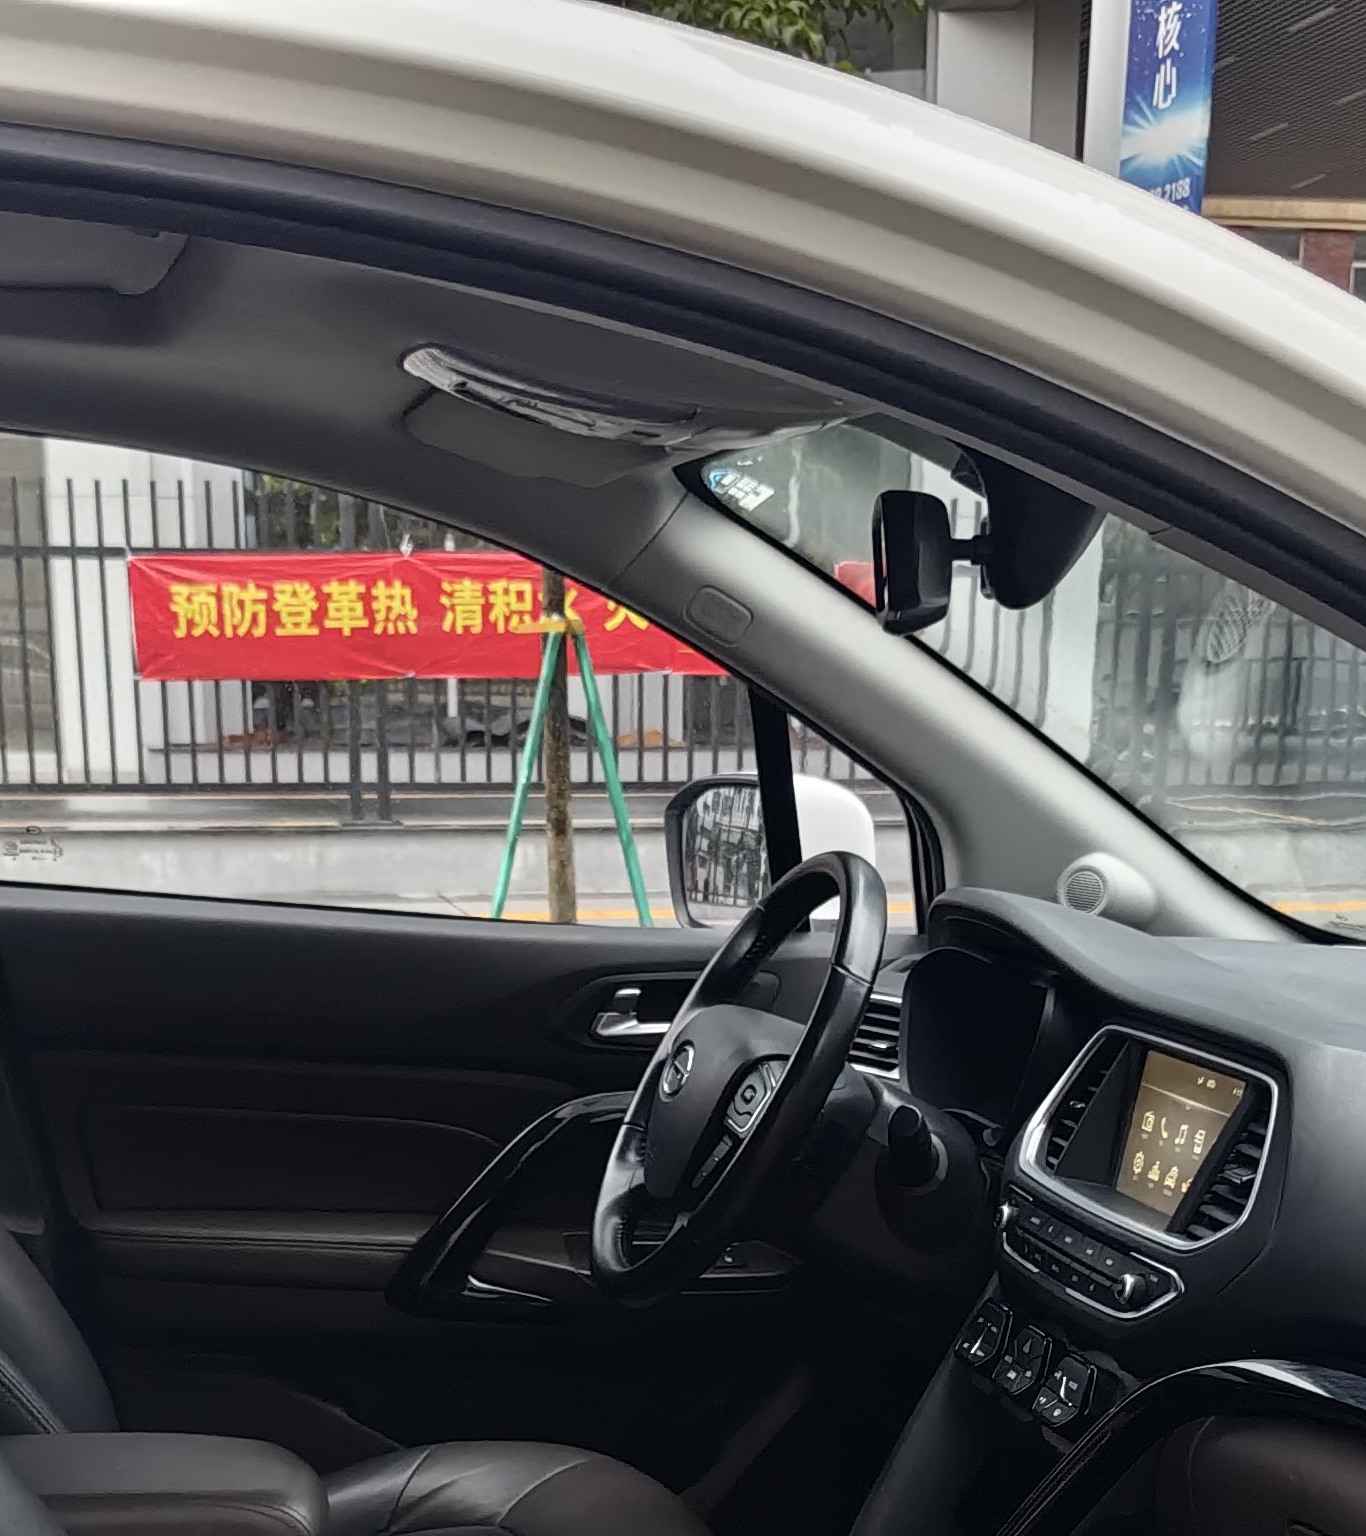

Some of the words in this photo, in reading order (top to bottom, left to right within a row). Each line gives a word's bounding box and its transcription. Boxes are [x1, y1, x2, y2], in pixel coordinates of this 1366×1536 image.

[1153, 1, 1182, 109] 核心
[169, 580, 419, 638] 预防登革热
